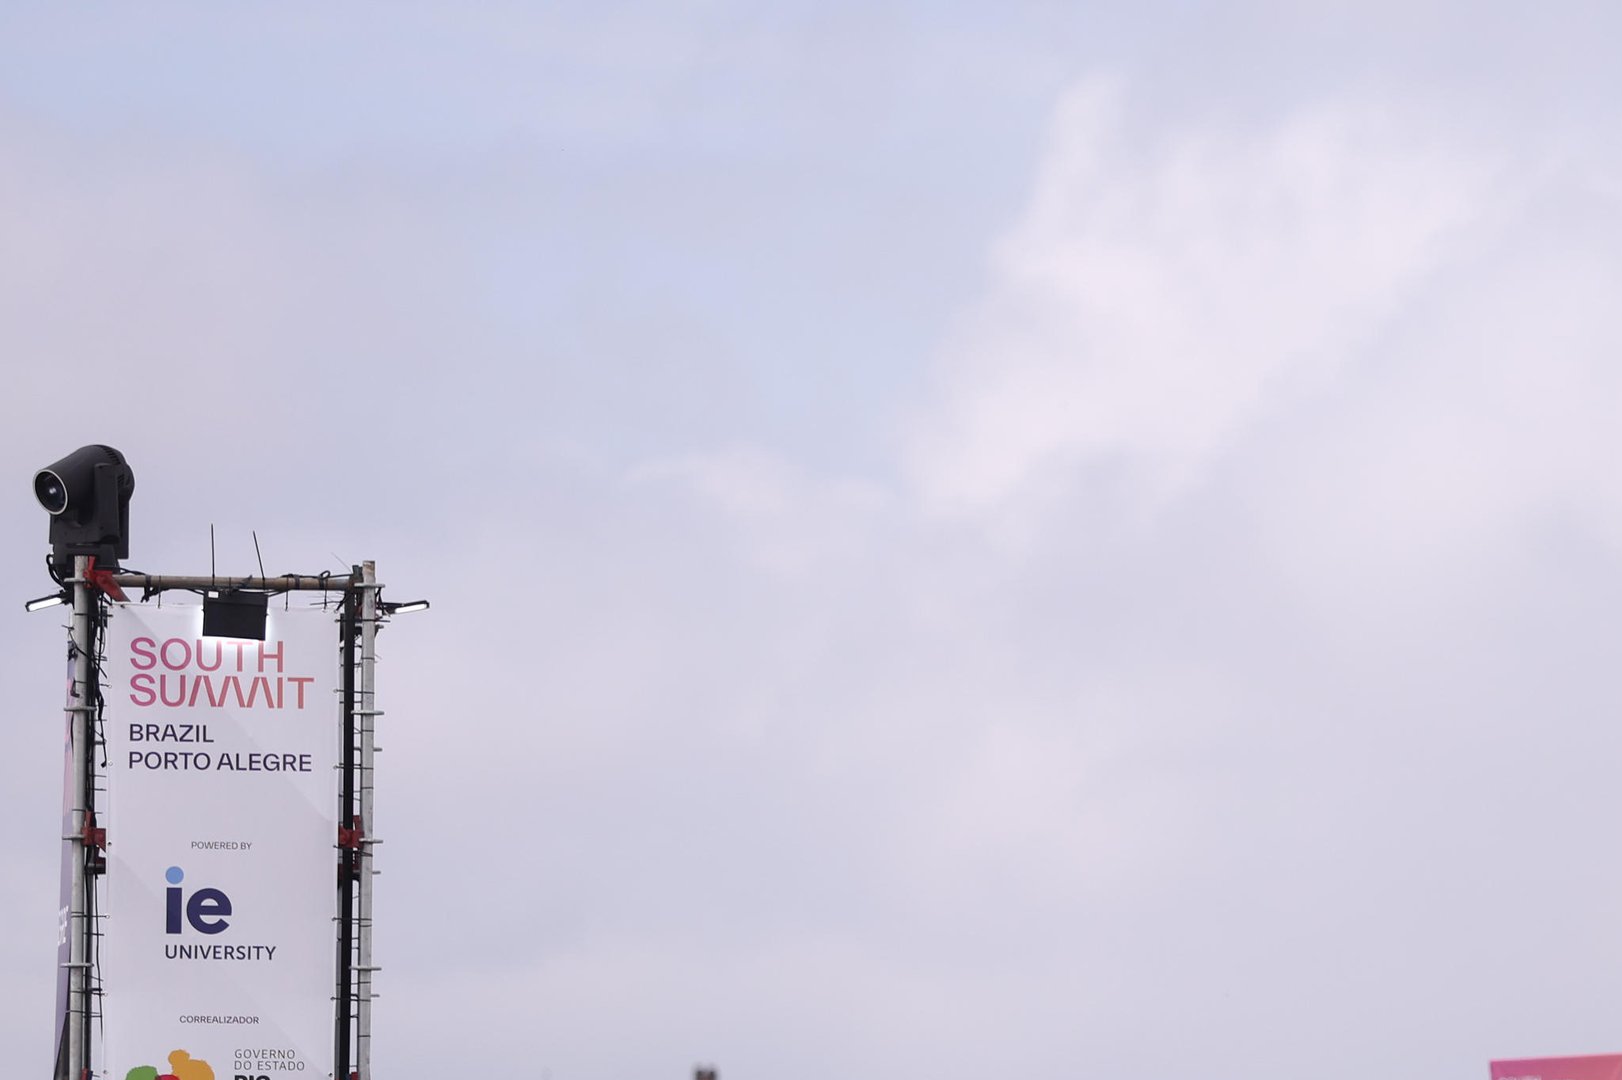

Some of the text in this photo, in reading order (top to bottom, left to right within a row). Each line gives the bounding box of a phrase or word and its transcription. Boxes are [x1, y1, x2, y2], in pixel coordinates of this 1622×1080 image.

[130, 636, 284, 673] SOUTH
[129, 673, 315, 709] SUMMIT
[129, 723, 215, 743] BRAZIL
[128, 751, 312, 772] PORTO ALEGRE
[191, 841, 252, 850] POWERED BY
[165, 865, 232, 935] ie
[165, 944, 276, 961] UNIVERSITY
[179, 1015, 260, 1025] CORREALIZADOR
[234, 1048, 296, 1060] GOVERNO
[234, 1060, 305, 1071] DO ESTADO
